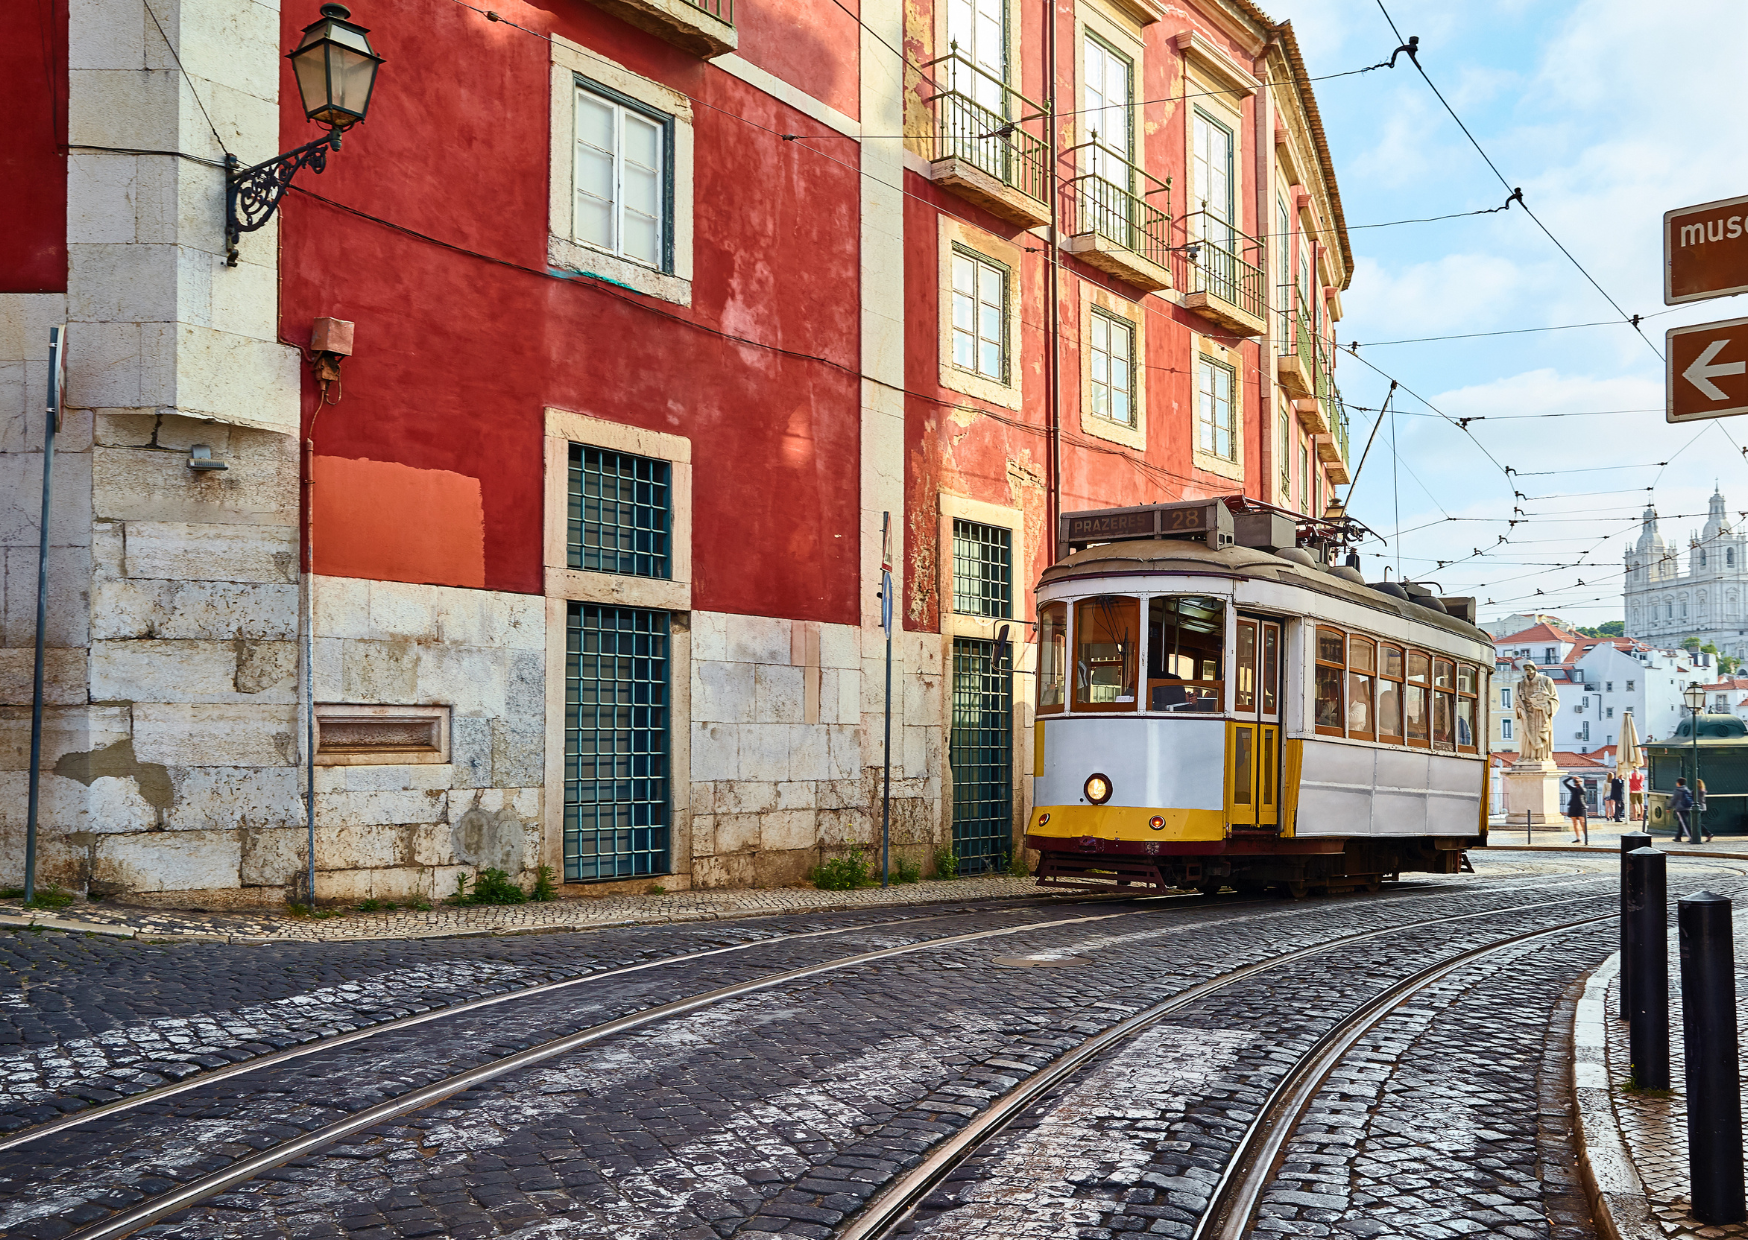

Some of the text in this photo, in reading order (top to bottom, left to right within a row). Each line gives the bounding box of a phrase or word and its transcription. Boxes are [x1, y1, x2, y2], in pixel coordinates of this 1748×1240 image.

[1681, 215, 1748, 247] mus
[1074, 514, 1146, 534] PRAZERES
[1171, 509, 1199, 529] 28
